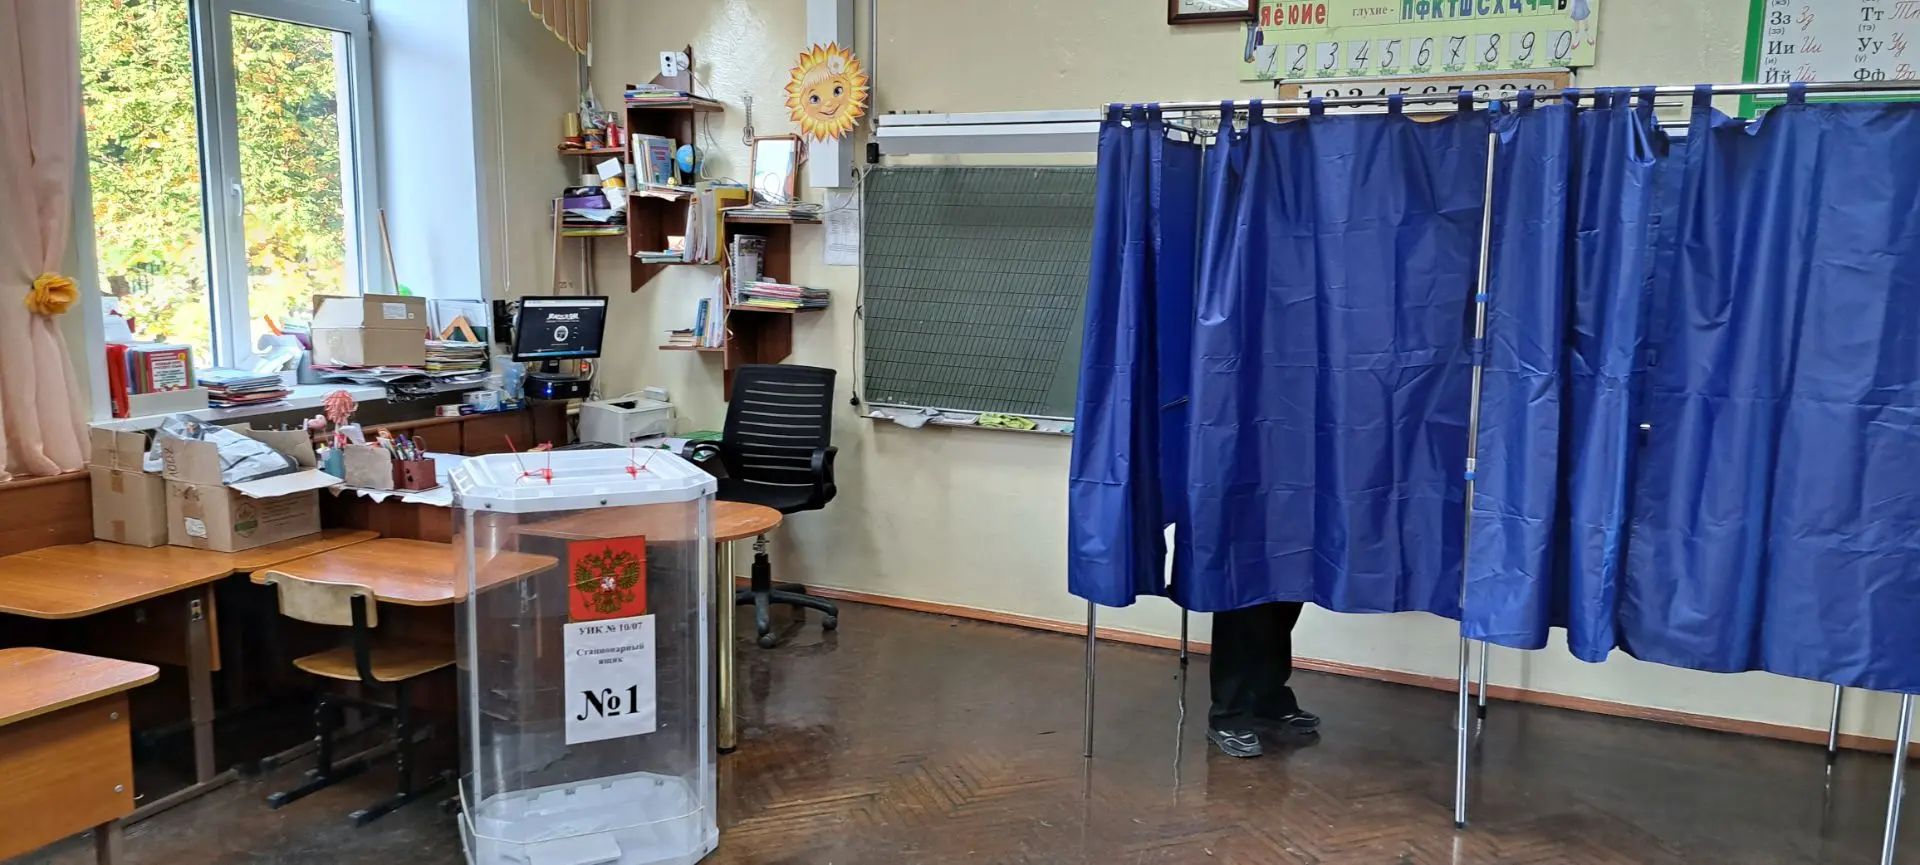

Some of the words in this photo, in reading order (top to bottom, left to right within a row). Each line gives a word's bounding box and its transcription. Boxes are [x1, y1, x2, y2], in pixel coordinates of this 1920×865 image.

[1352, 6, 1388, 18] глухие
[1267, 45, 1279, 73] 1
[1291, 43, 1308, 71] 2
[1324, 42, 1339, 70] 3
[1355, 41, 1369, 68] 4
[1381, 40, 1401, 68] 5
[1417, 37, 1433, 66] 6
[1450, 35, 1466, 64] 7
[1484, 33, 1500, 62] 8
[1519, 31, 1535, 61] 9
[1554, 30, 1572, 59] 0
[579, 626, 603, 635] УИК
[576, 641, 644, 656] Стационарный
